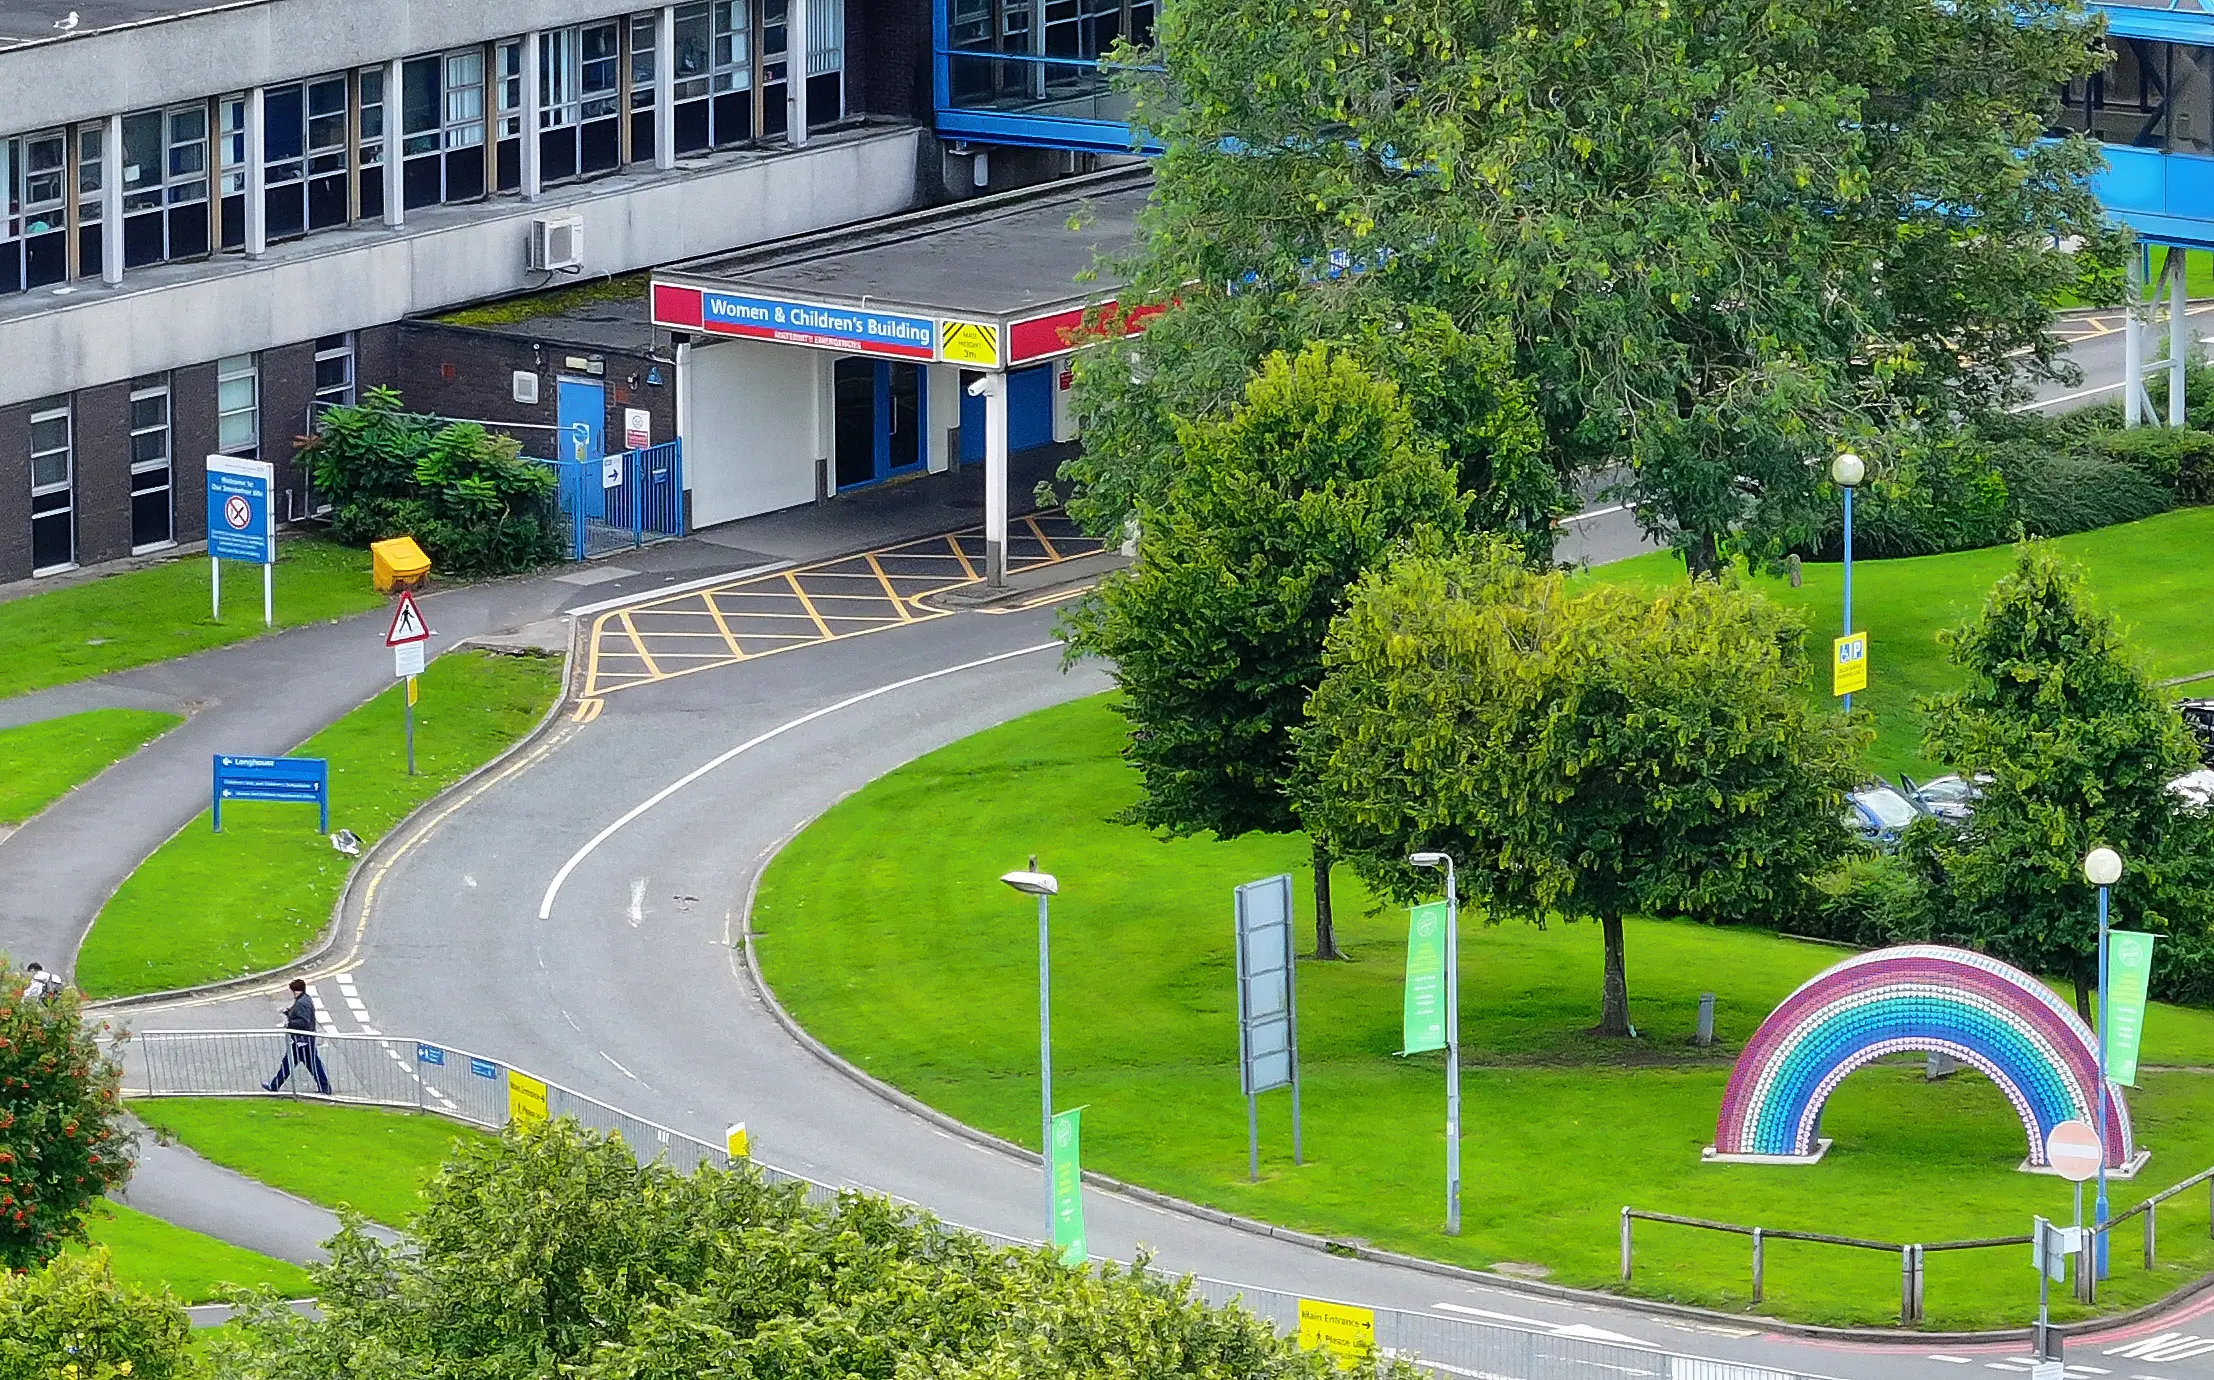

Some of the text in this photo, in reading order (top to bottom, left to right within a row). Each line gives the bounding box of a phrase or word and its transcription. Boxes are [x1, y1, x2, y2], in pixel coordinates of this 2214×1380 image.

[711, 298, 930, 346] Women & Children's Building
[235, 758, 275, 767] Longhouse
[1301, 1310, 1360, 1328] Main Entrance
